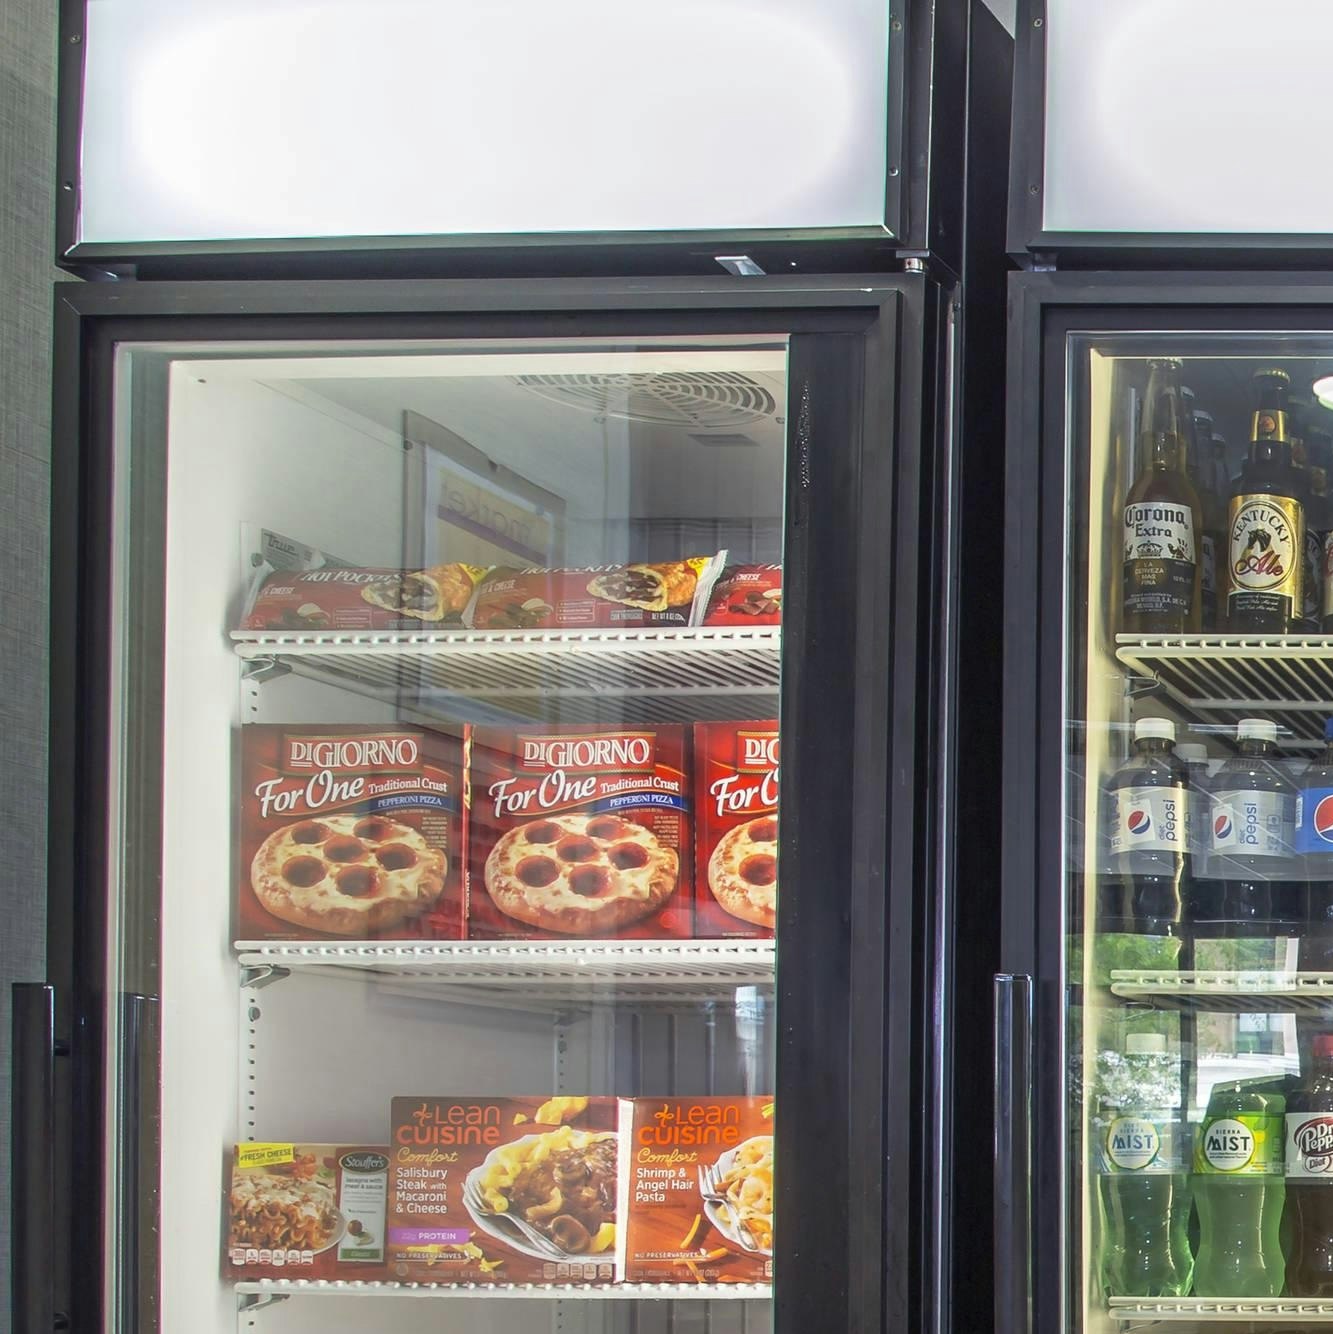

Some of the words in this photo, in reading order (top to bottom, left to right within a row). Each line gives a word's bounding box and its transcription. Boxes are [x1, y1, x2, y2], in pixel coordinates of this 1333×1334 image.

[1125, 506, 1185, 528] Corona
[1135, 524, 1172, 537] Extra
[1232, 508, 1292, 544] KENTUCKY
[1235, 549, 1284, 577] Ale
[290, 739, 418, 768] DIGIORNO
[523, 738, 650, 768] DIGIORNO
[368, 777, 420, 794] Traditional
[421, 779, 448, 793] Crust
[488, 776, 538, 818] For
[539, 769, 596, 808] One
[600, 776, 652, 794] Traditional
[653, 776, 679, 792] Crust
[255, 777, 304, 818] For
[306, 770, 365, 807] One
[378, 796, 419, 808] PEPPERONI
[419, 796, 442, 805] PIZZA
[609, 794, 650, 808] PEPPERONI
[651, 794, 674, 804] PIZZA
[710, 776, 763, 817] For
[1163, 798, 1179, 842] pepsi
[1244, 802, 1258, 845] pepsi
[1207, 1135, 1251, 1152] MIST
[345, 1155, 384, 1168] Stouffer's
[396, 1147, 458, 1167] Comfort
[637, 1148, 698, 1167] Comfort
[396, 1167, 448, 1180] Salisbury
[636, 1167, 676, 1181] Shrimp
[678, 1168, 686, 1178] &
[396, 1180, 427, 1191] Steak
[636, 1180, 669, 1192] Angel
[671, 1180, 694, 1190] Hair
[396, 1191, 447, 1202] Macaroni
[635, 1192, 665, 1202] Pasta
[396, 1203, 404, 1214] &
[406, 1203, 447, 1214] Cheese
[418, 1232, 457, 1240] PROTEIN
